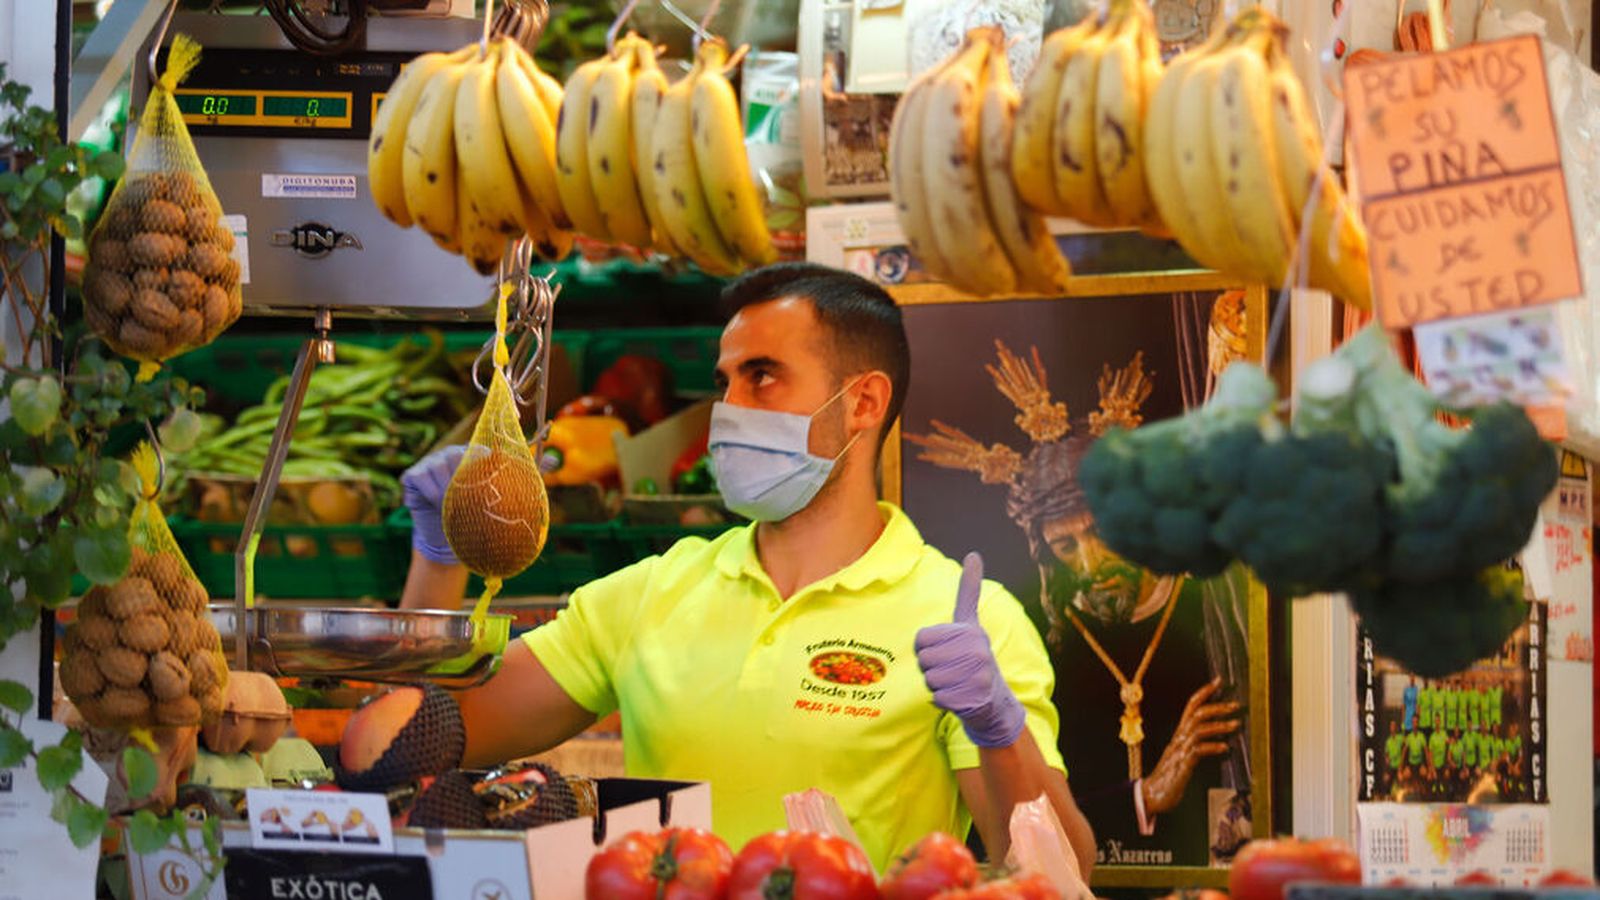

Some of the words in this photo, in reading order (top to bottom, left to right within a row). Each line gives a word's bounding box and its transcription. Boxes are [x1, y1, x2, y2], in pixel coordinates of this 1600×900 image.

[1360, 46, 1526, 107] PELAMOS
[1413, 108, 1457, 144] SU
[1370, 181, 1556, 242] CUIDAMOS
[1437, 236, 1482, 274] DE
[1398, 268, 1546, 323] USTED
[800, 679, 847, 698] Desde
[851, 689, 887, 701] 1957
[1529, 601, 1541, 745] ARRIAS
[1366, 748, 1375, 798] CF
[1532, 752, 1541, 802] CF
[1107, 839, 1173, 864] Nazareno
[271, 874, 382, 900] EXÓTICA
